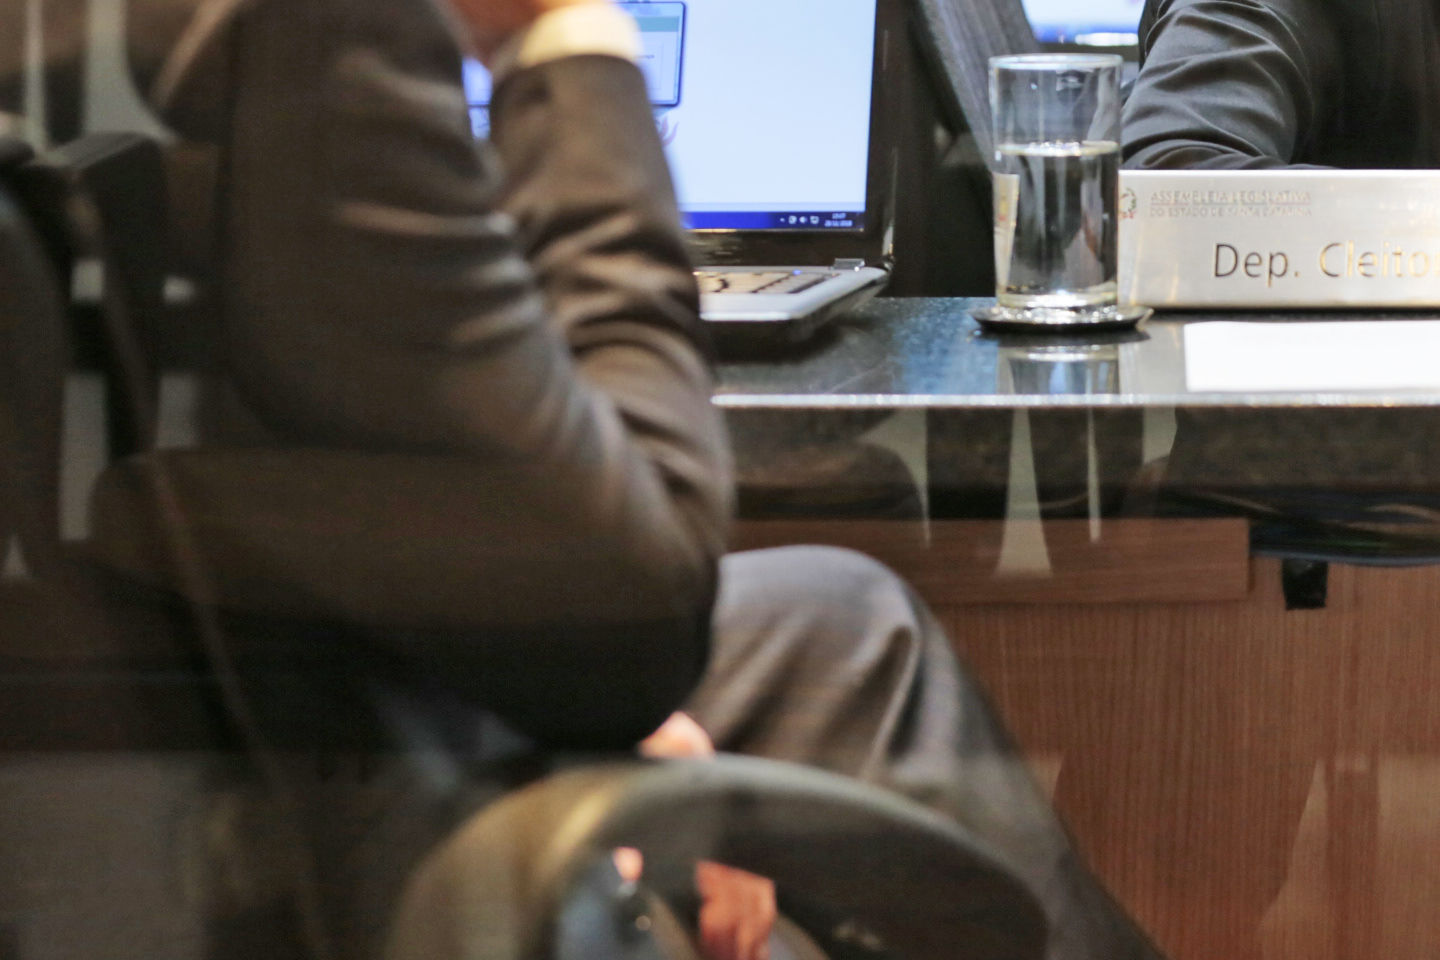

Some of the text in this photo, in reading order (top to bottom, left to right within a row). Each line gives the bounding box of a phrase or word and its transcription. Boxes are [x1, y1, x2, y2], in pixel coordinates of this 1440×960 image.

[1150, 190, 1311, 203] ASSEMBLEIA LEGISLATIVA
[1213, 242, 1300, 288] Dep.
